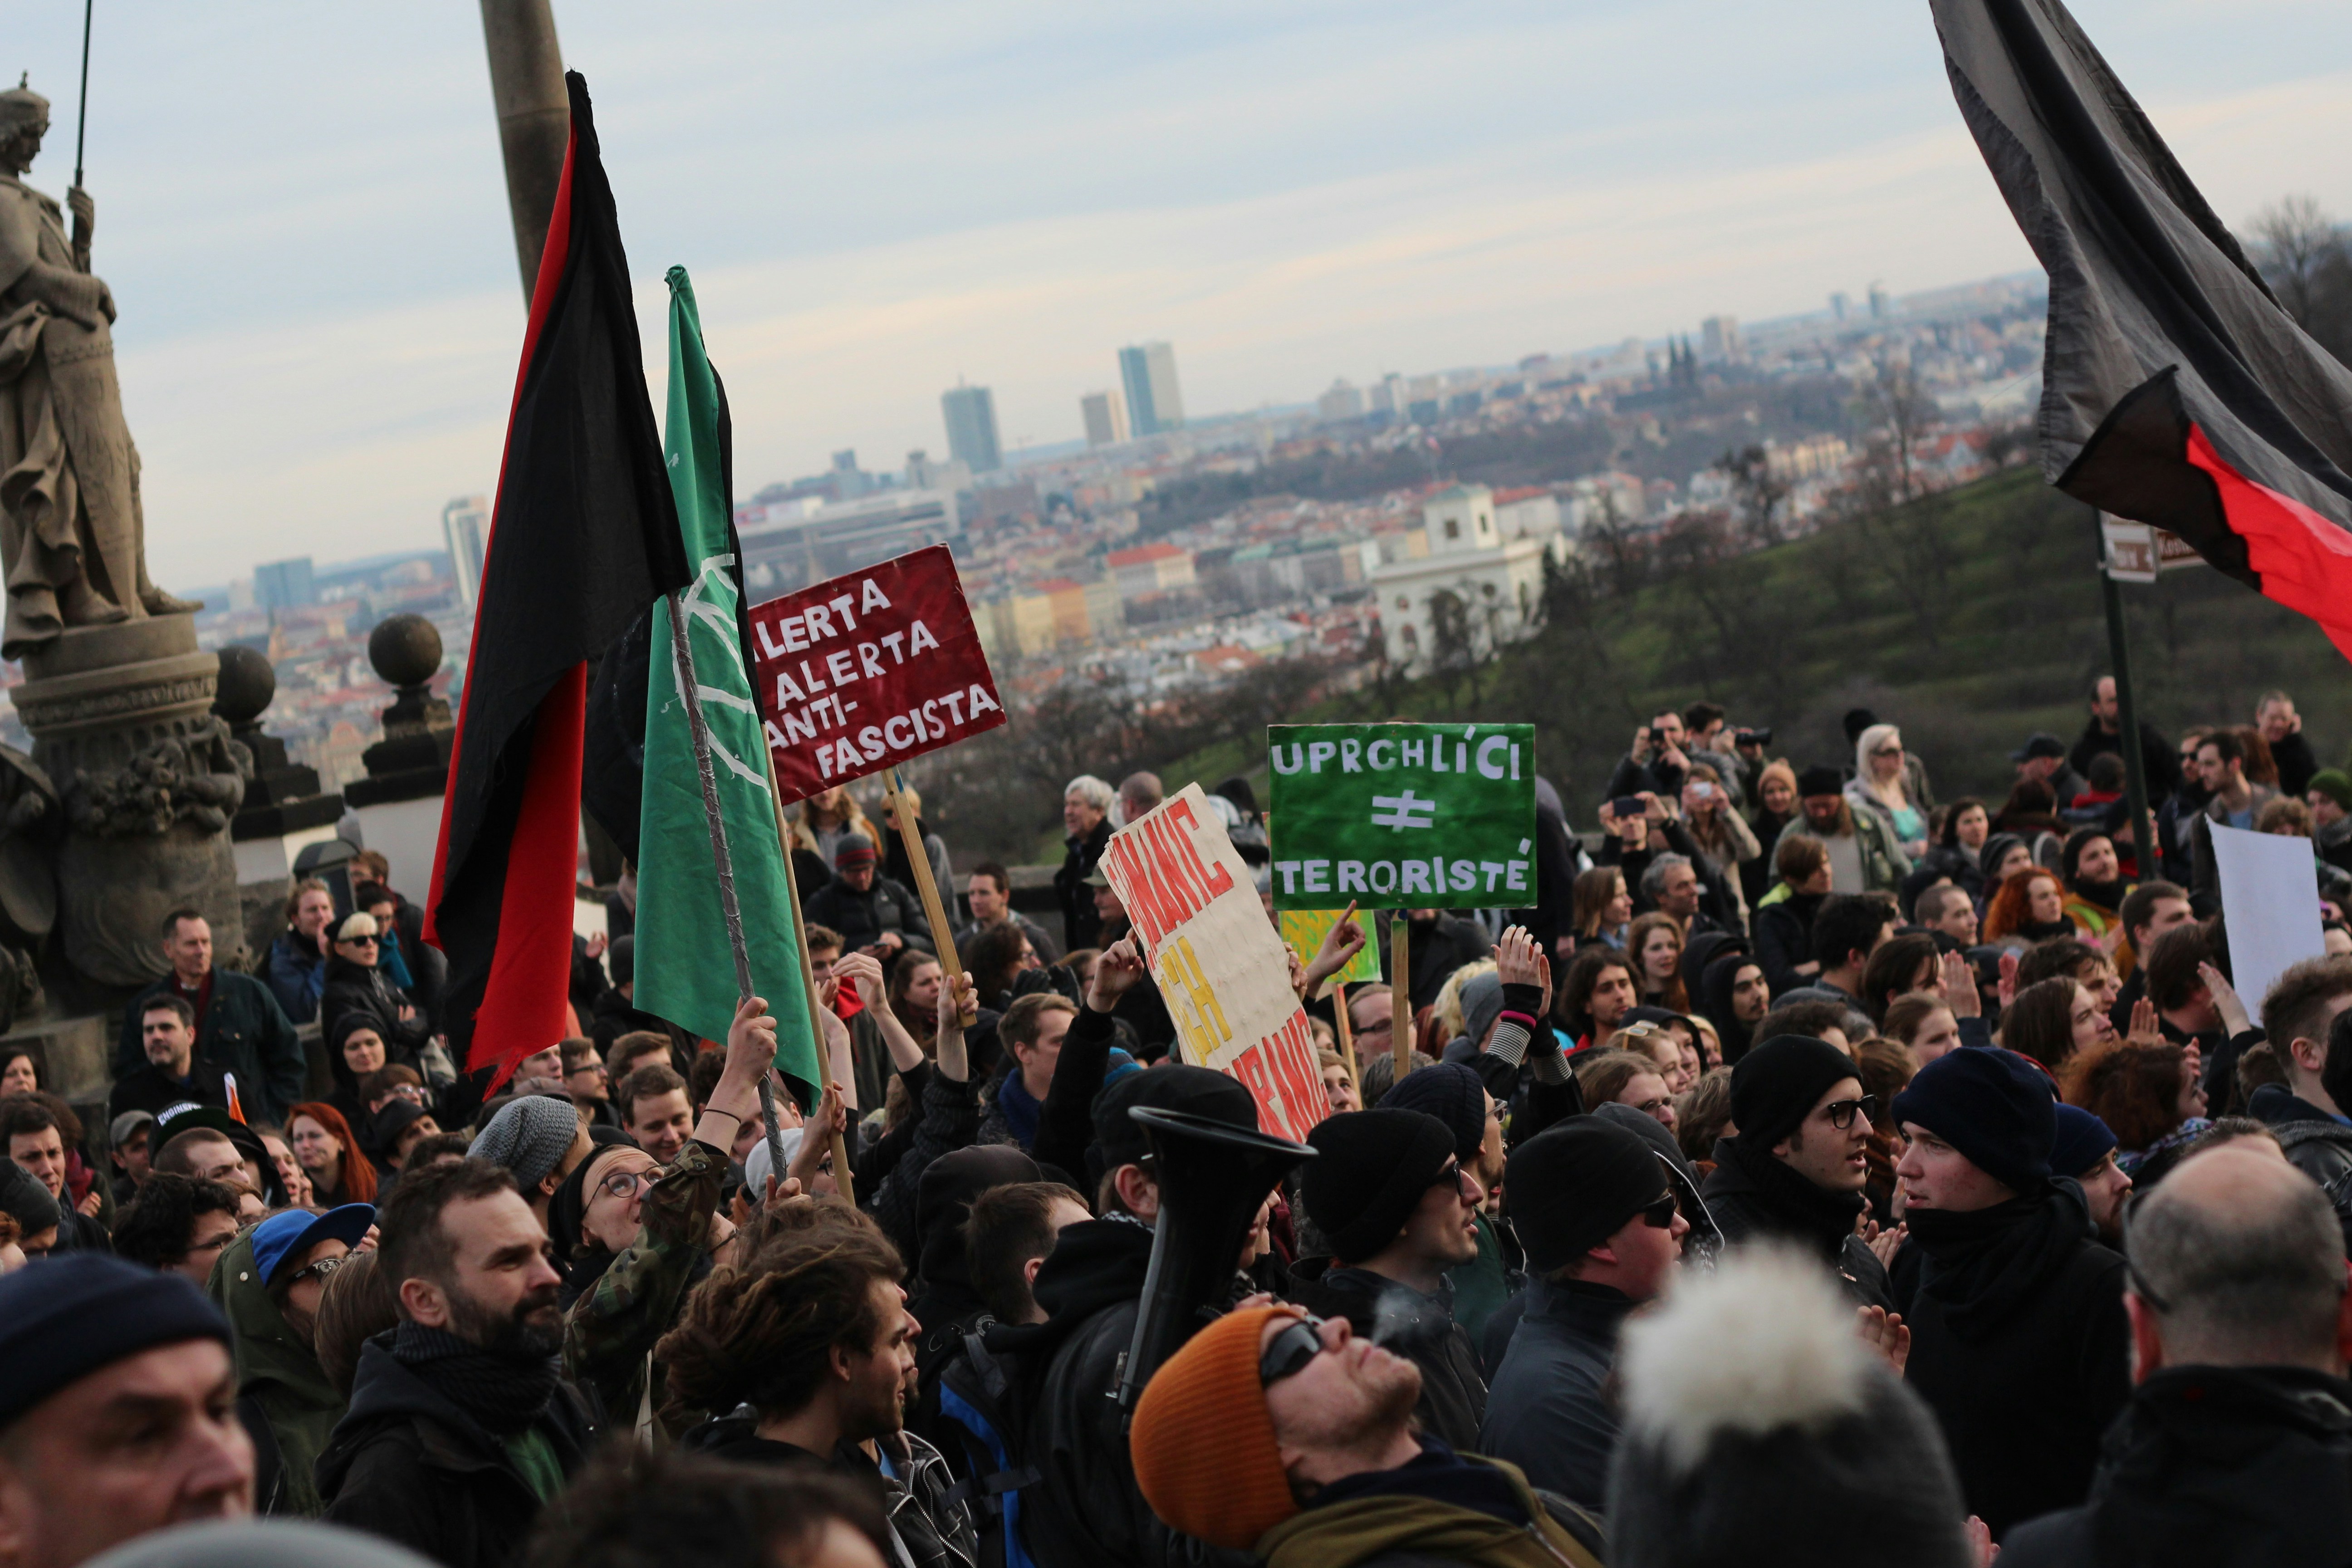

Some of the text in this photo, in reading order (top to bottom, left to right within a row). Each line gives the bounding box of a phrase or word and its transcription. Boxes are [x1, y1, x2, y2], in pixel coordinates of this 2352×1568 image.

[754, 578, 892, 662] LERTA
[776, 620, 940, 711] ALERTA
[765, 692, 858, 749] ANTI-
[815, 683, 1000, 779] FASCISTA
[1271, 725, 1520, 780] UPRCHLÍCI
[1274, 838, 1532, 894] TERORISTÉ
